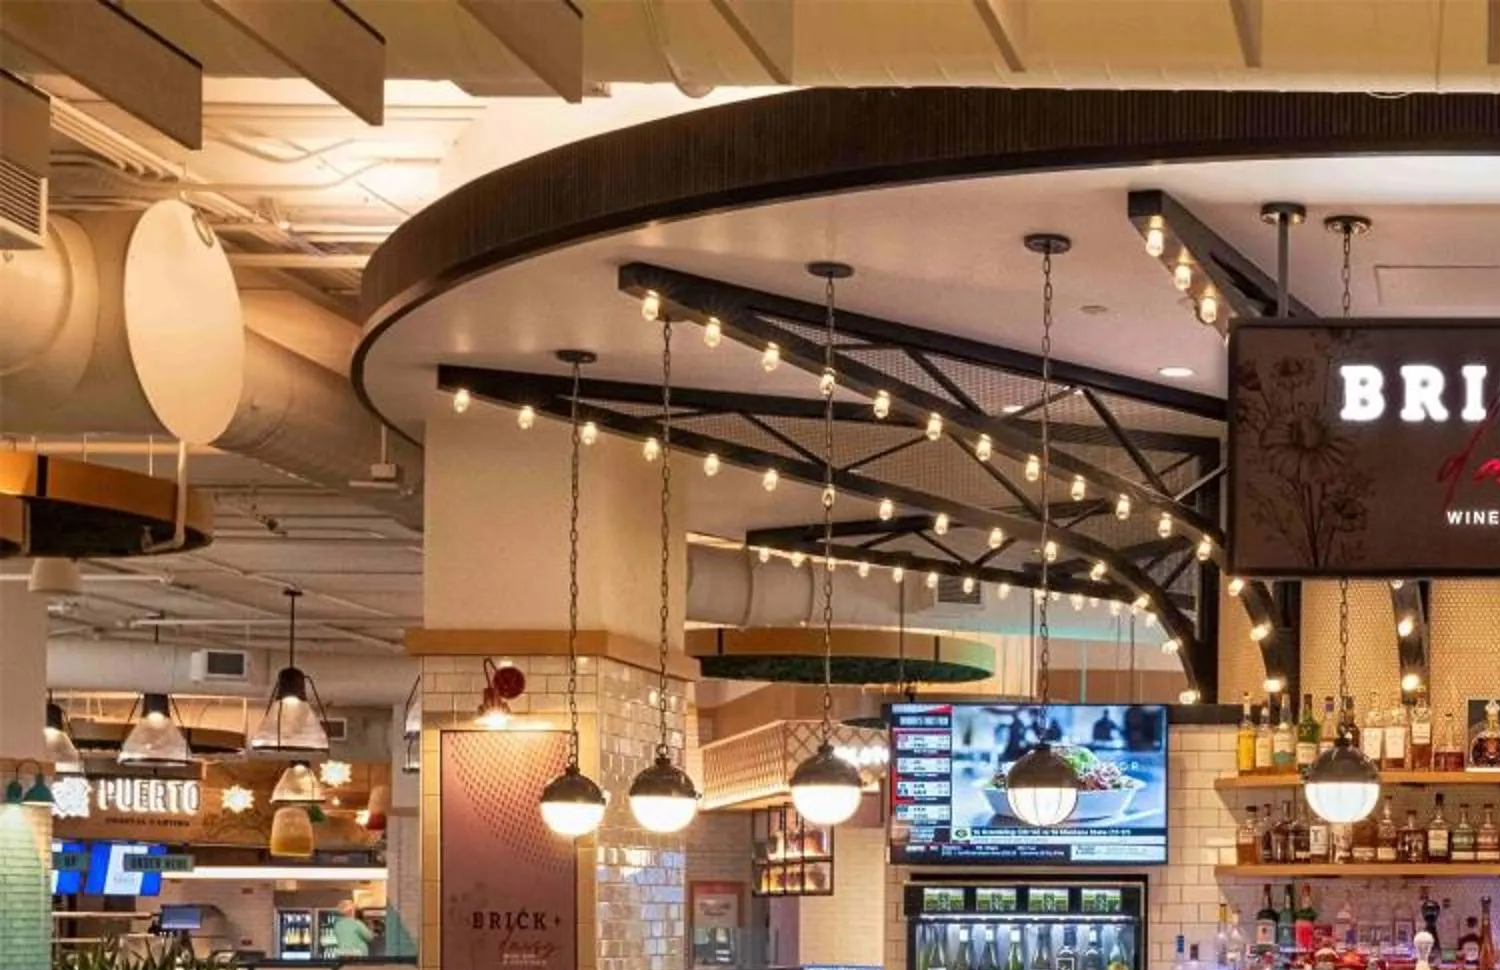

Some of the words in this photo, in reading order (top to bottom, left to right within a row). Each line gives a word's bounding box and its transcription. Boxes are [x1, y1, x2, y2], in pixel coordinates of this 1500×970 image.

[1447, 510, 1499, 525] WINE
[98, 778, 200, 815] PUERTO
[472, 911, 546, 930] BRICK
